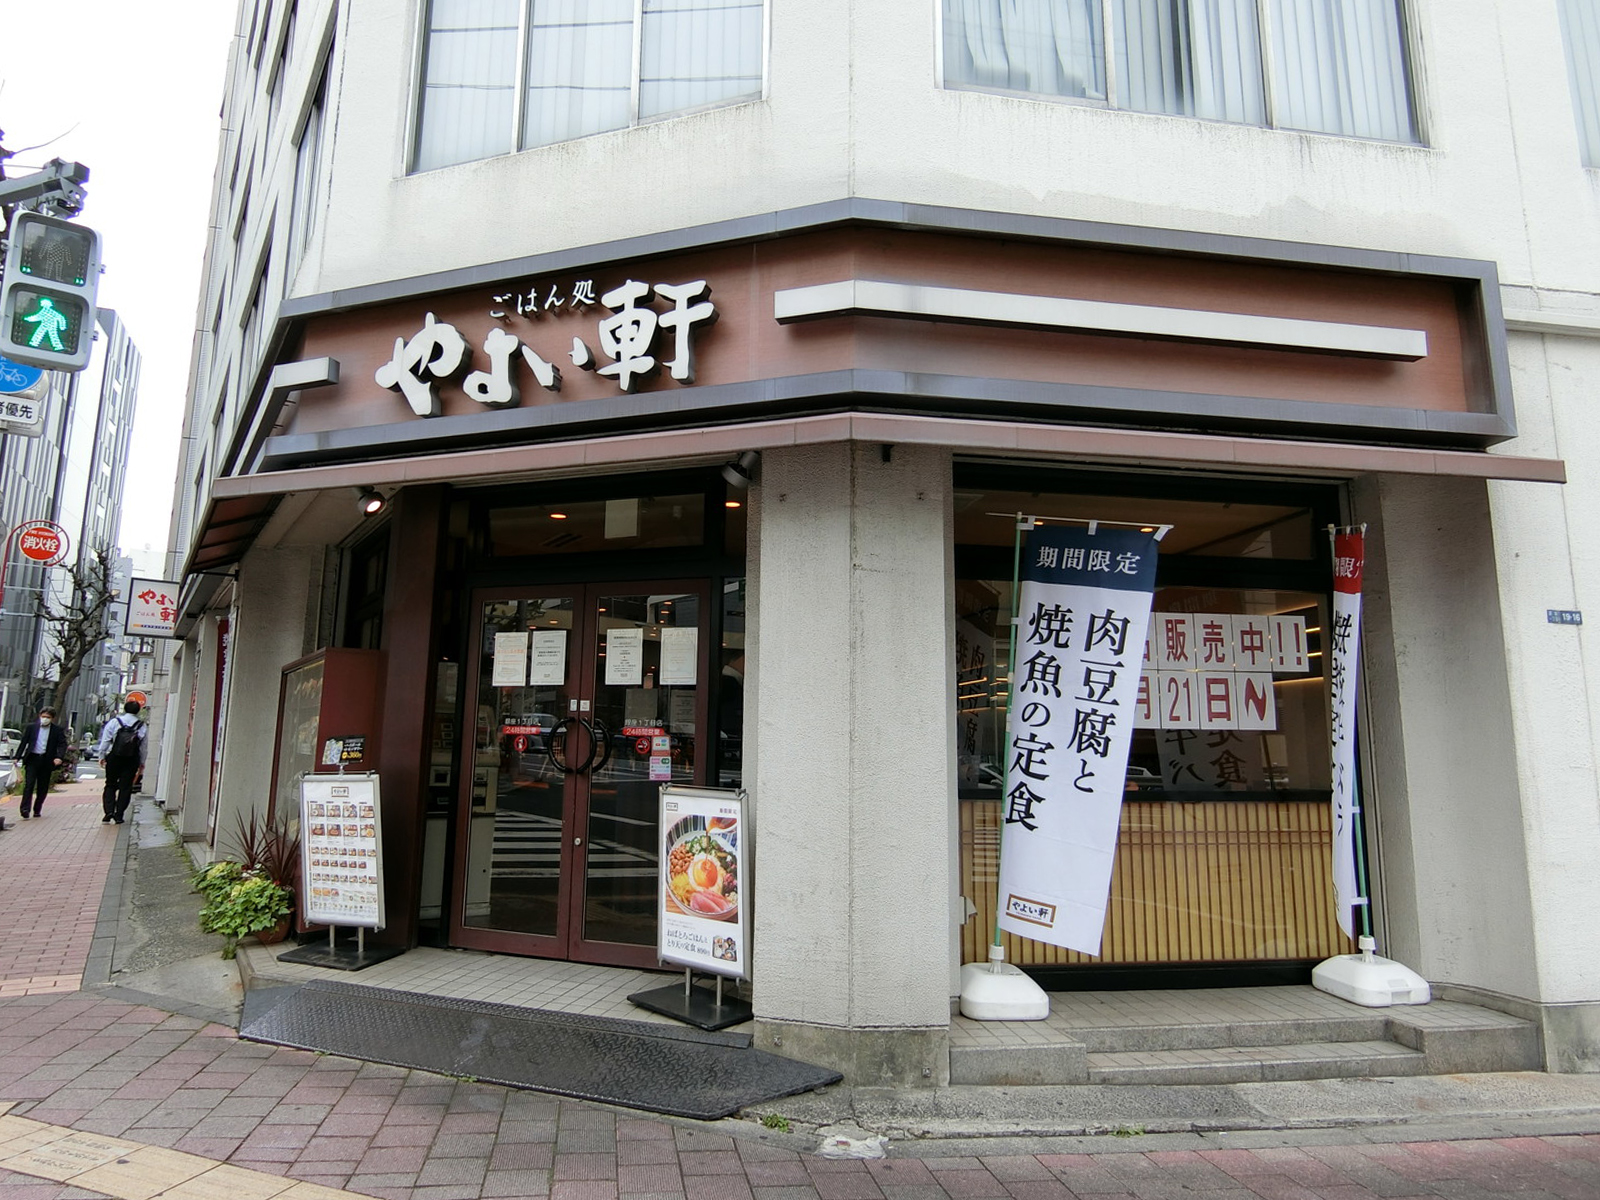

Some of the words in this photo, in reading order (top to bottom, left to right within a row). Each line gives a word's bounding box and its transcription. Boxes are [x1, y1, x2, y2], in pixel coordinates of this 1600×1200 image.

[489, 279, 596, 318] ごはん処
[374, 279, 716, 417] やよい軒
[23, 535, 58, 552] 消火栓
[1036, 546, 1141, 575] 期間限定
[1005, 602, 1074, 832] 焼魚の定食
[1067, 609, 1130, 793] 肉豆腐と
[1012, 901, 1049, 918] やよい軒
